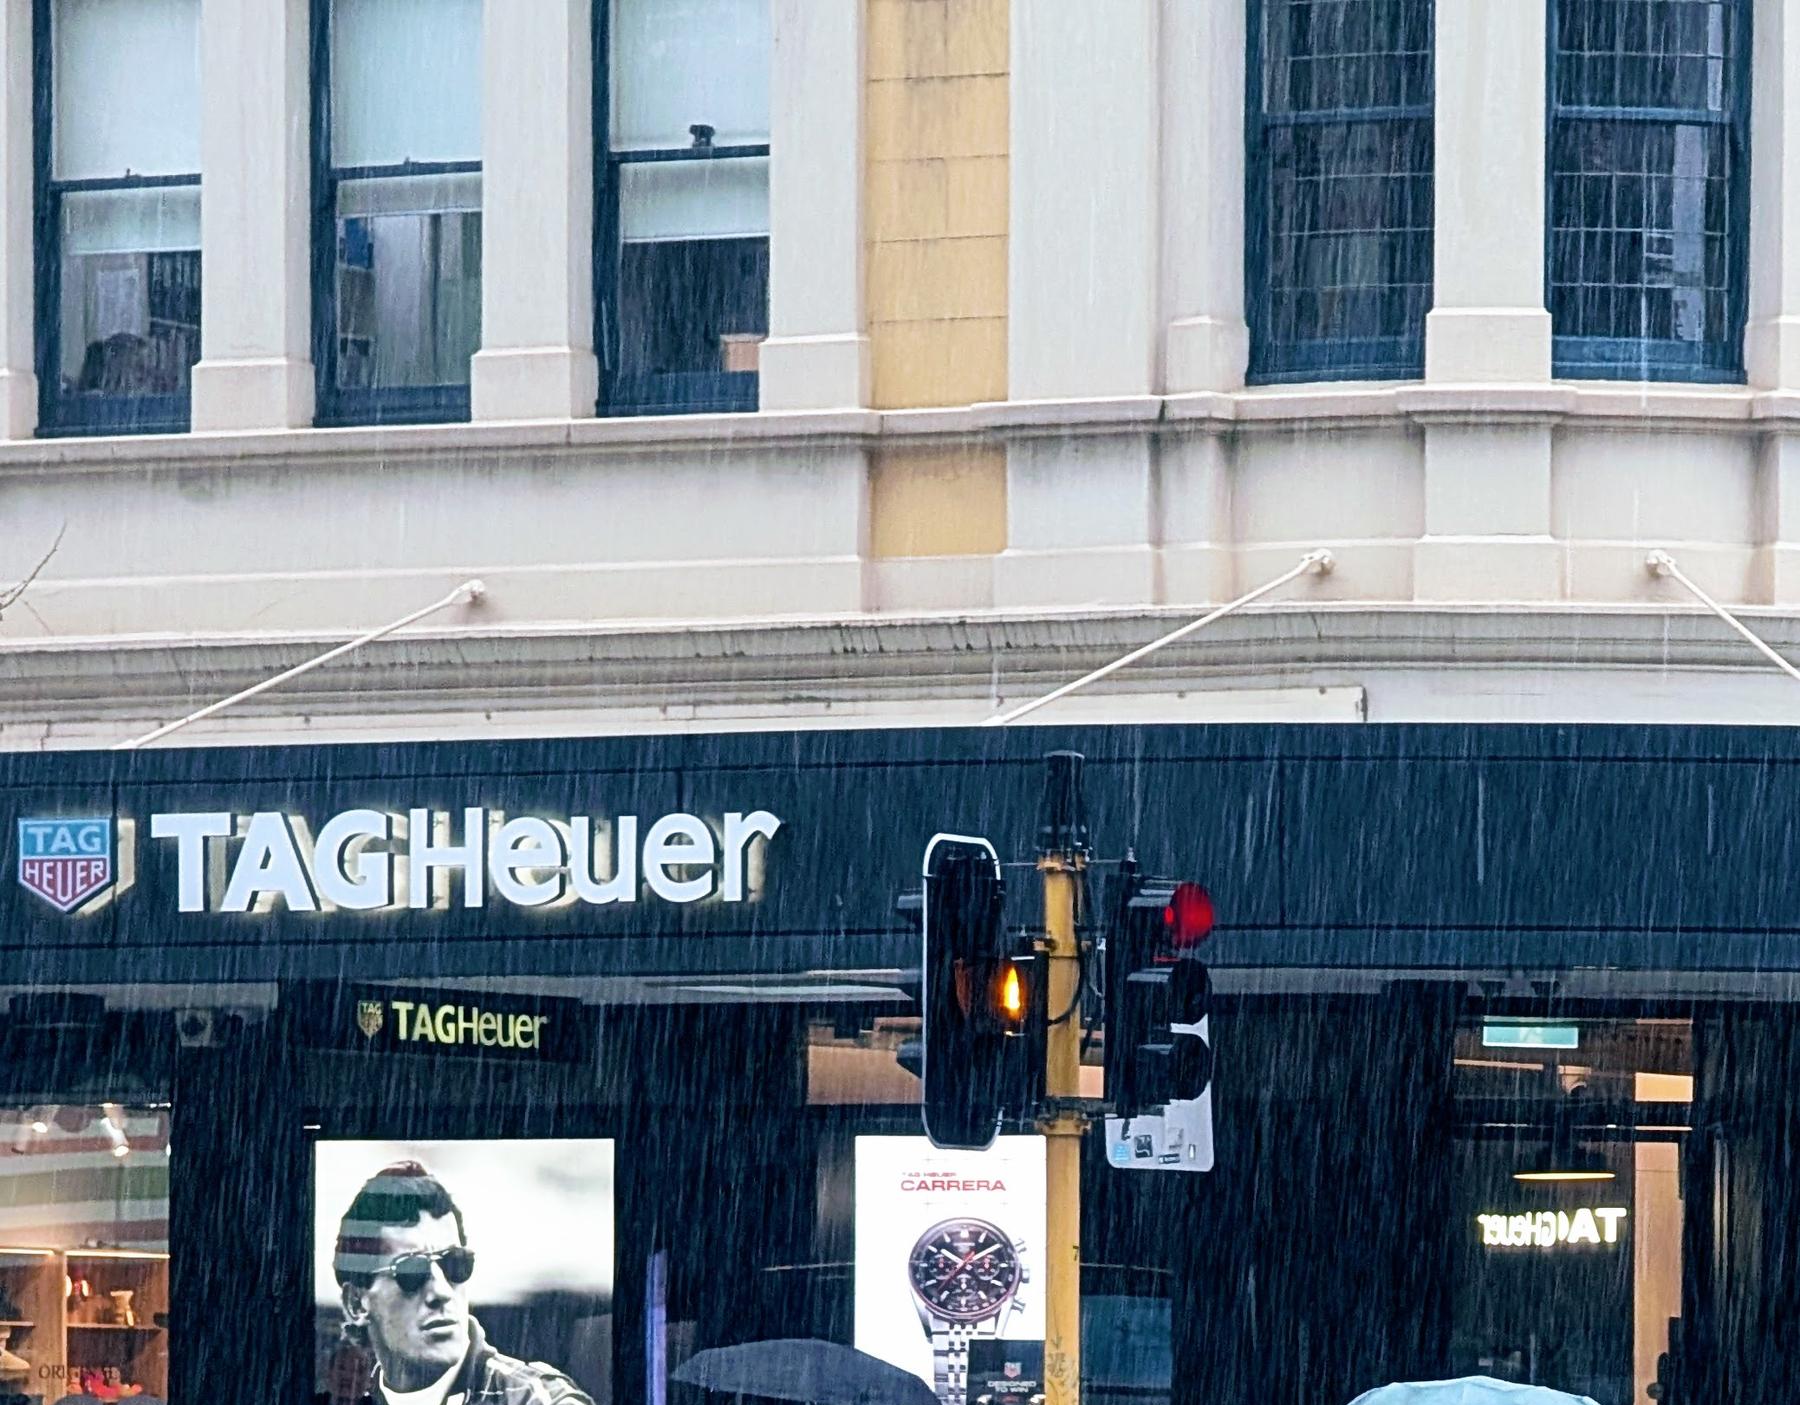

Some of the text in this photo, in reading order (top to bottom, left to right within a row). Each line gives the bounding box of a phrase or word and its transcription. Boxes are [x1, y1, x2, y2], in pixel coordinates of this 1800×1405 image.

[26, 825, 101, 853] TAG
[25, 860, 104, 902] HEUER
[900, 1180, 1007, 1191] CARRERA
